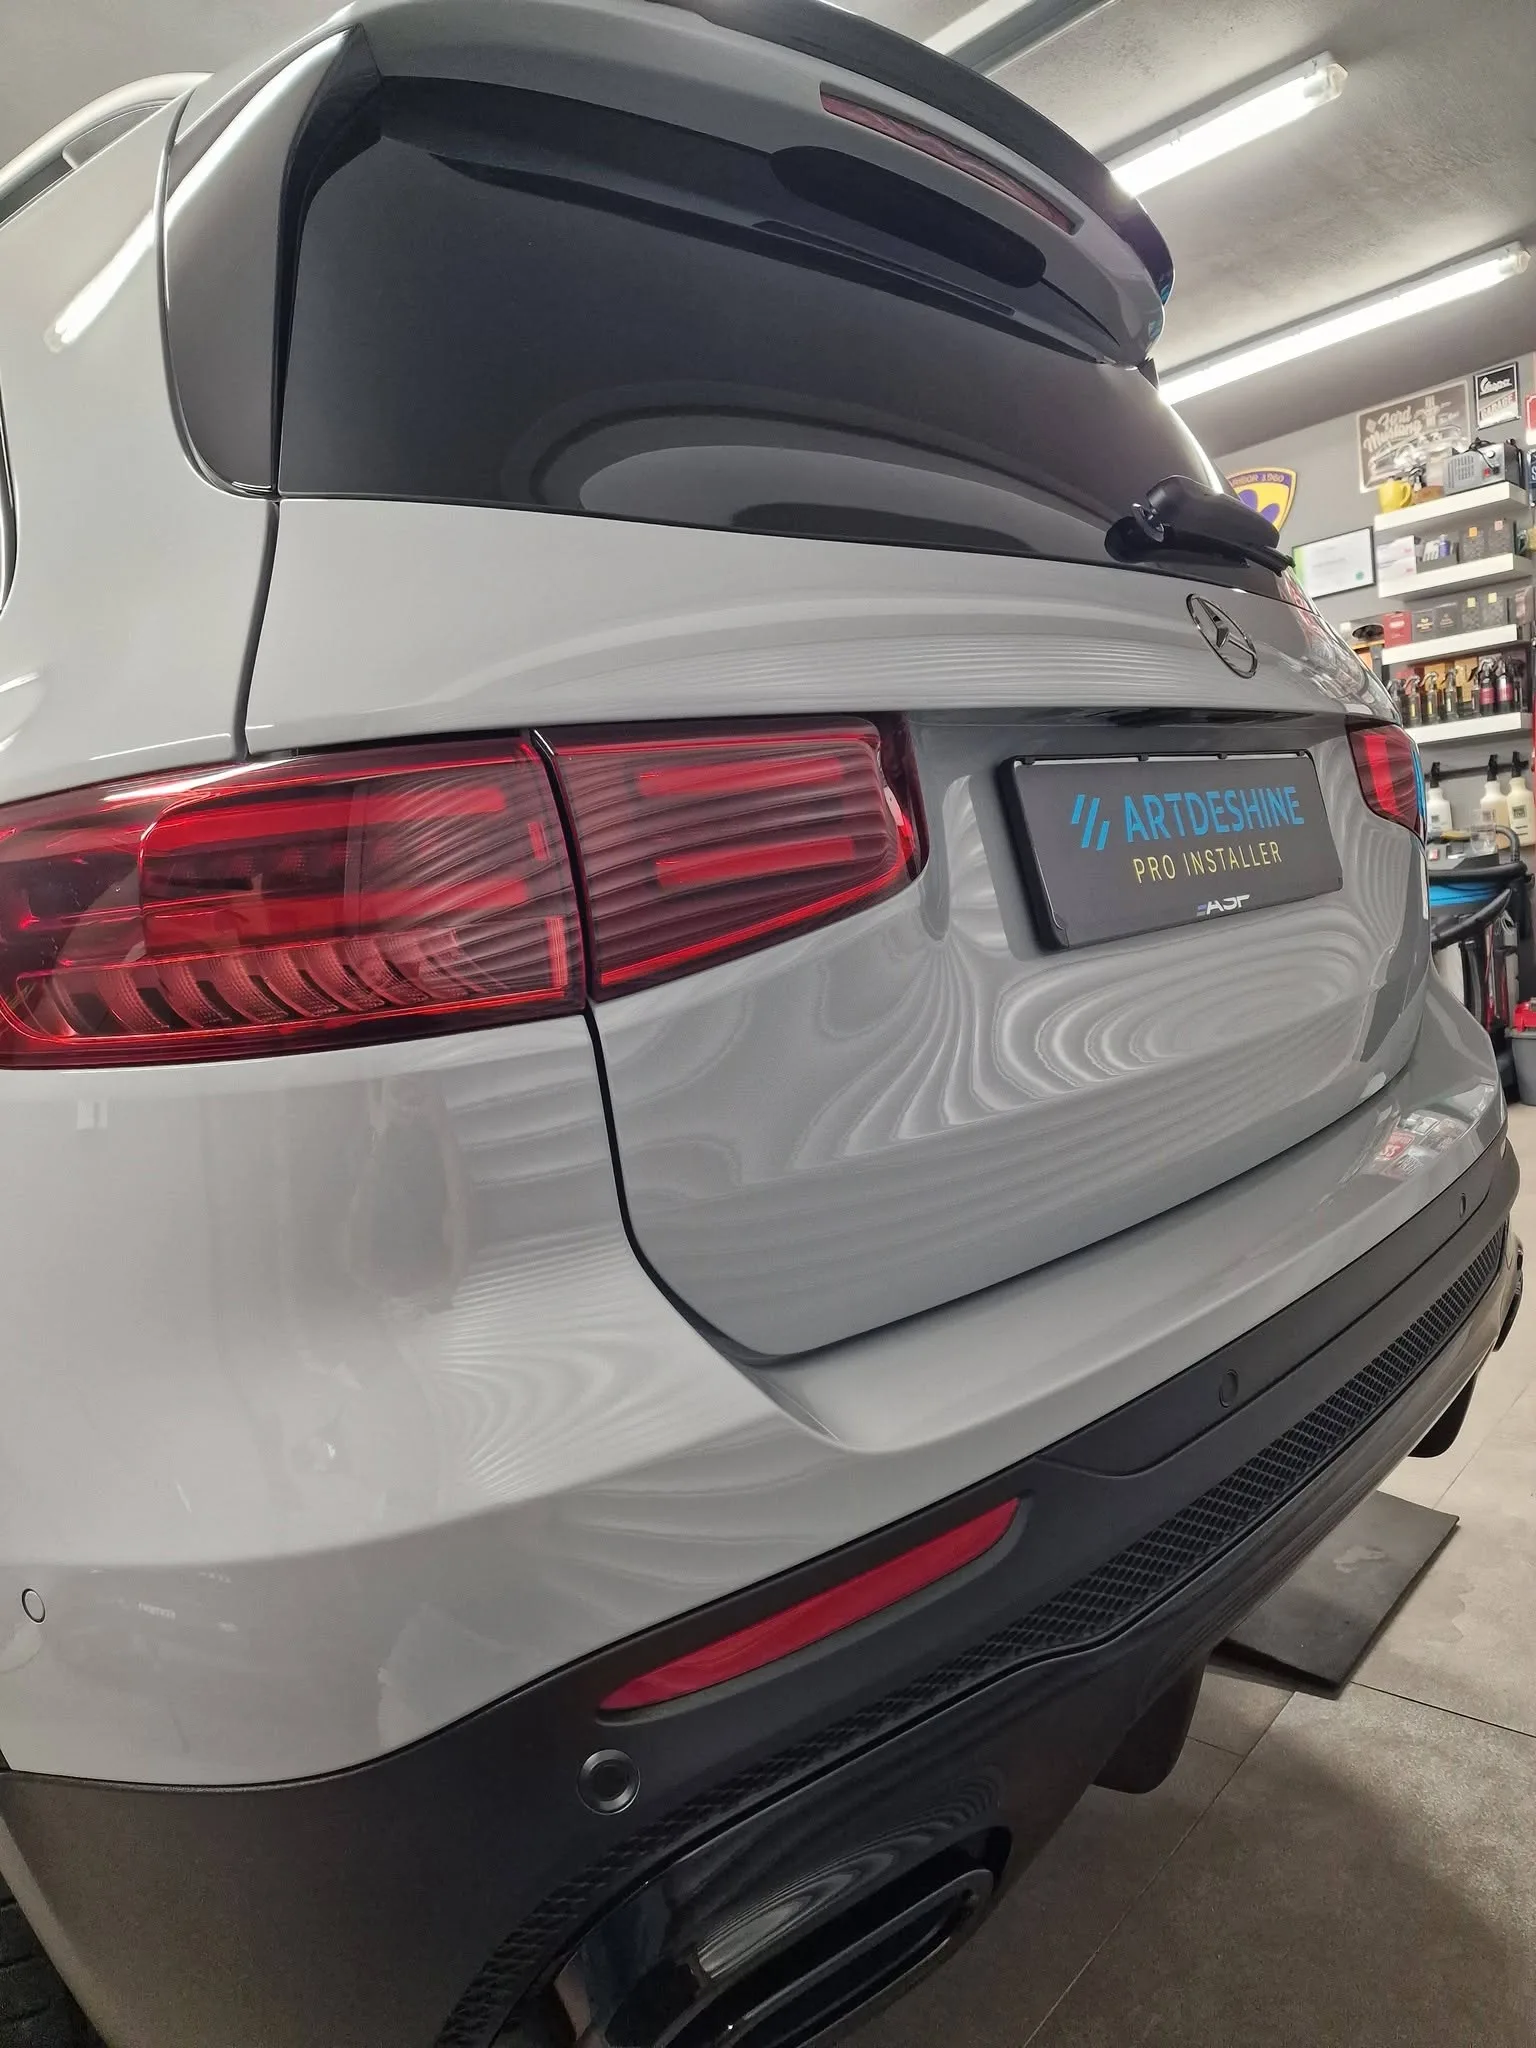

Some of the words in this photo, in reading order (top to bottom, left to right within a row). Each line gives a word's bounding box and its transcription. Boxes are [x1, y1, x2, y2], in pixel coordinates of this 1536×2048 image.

[1363, 419, 1422, 453] Mustang
[1378, 405, 1412, 430] Ford
[1124, 786, 1304, 842] ARTDESHINE
[1133, 855, 1175, 884] PRO
[1183, 841, 1282, 877] INSTALLER
